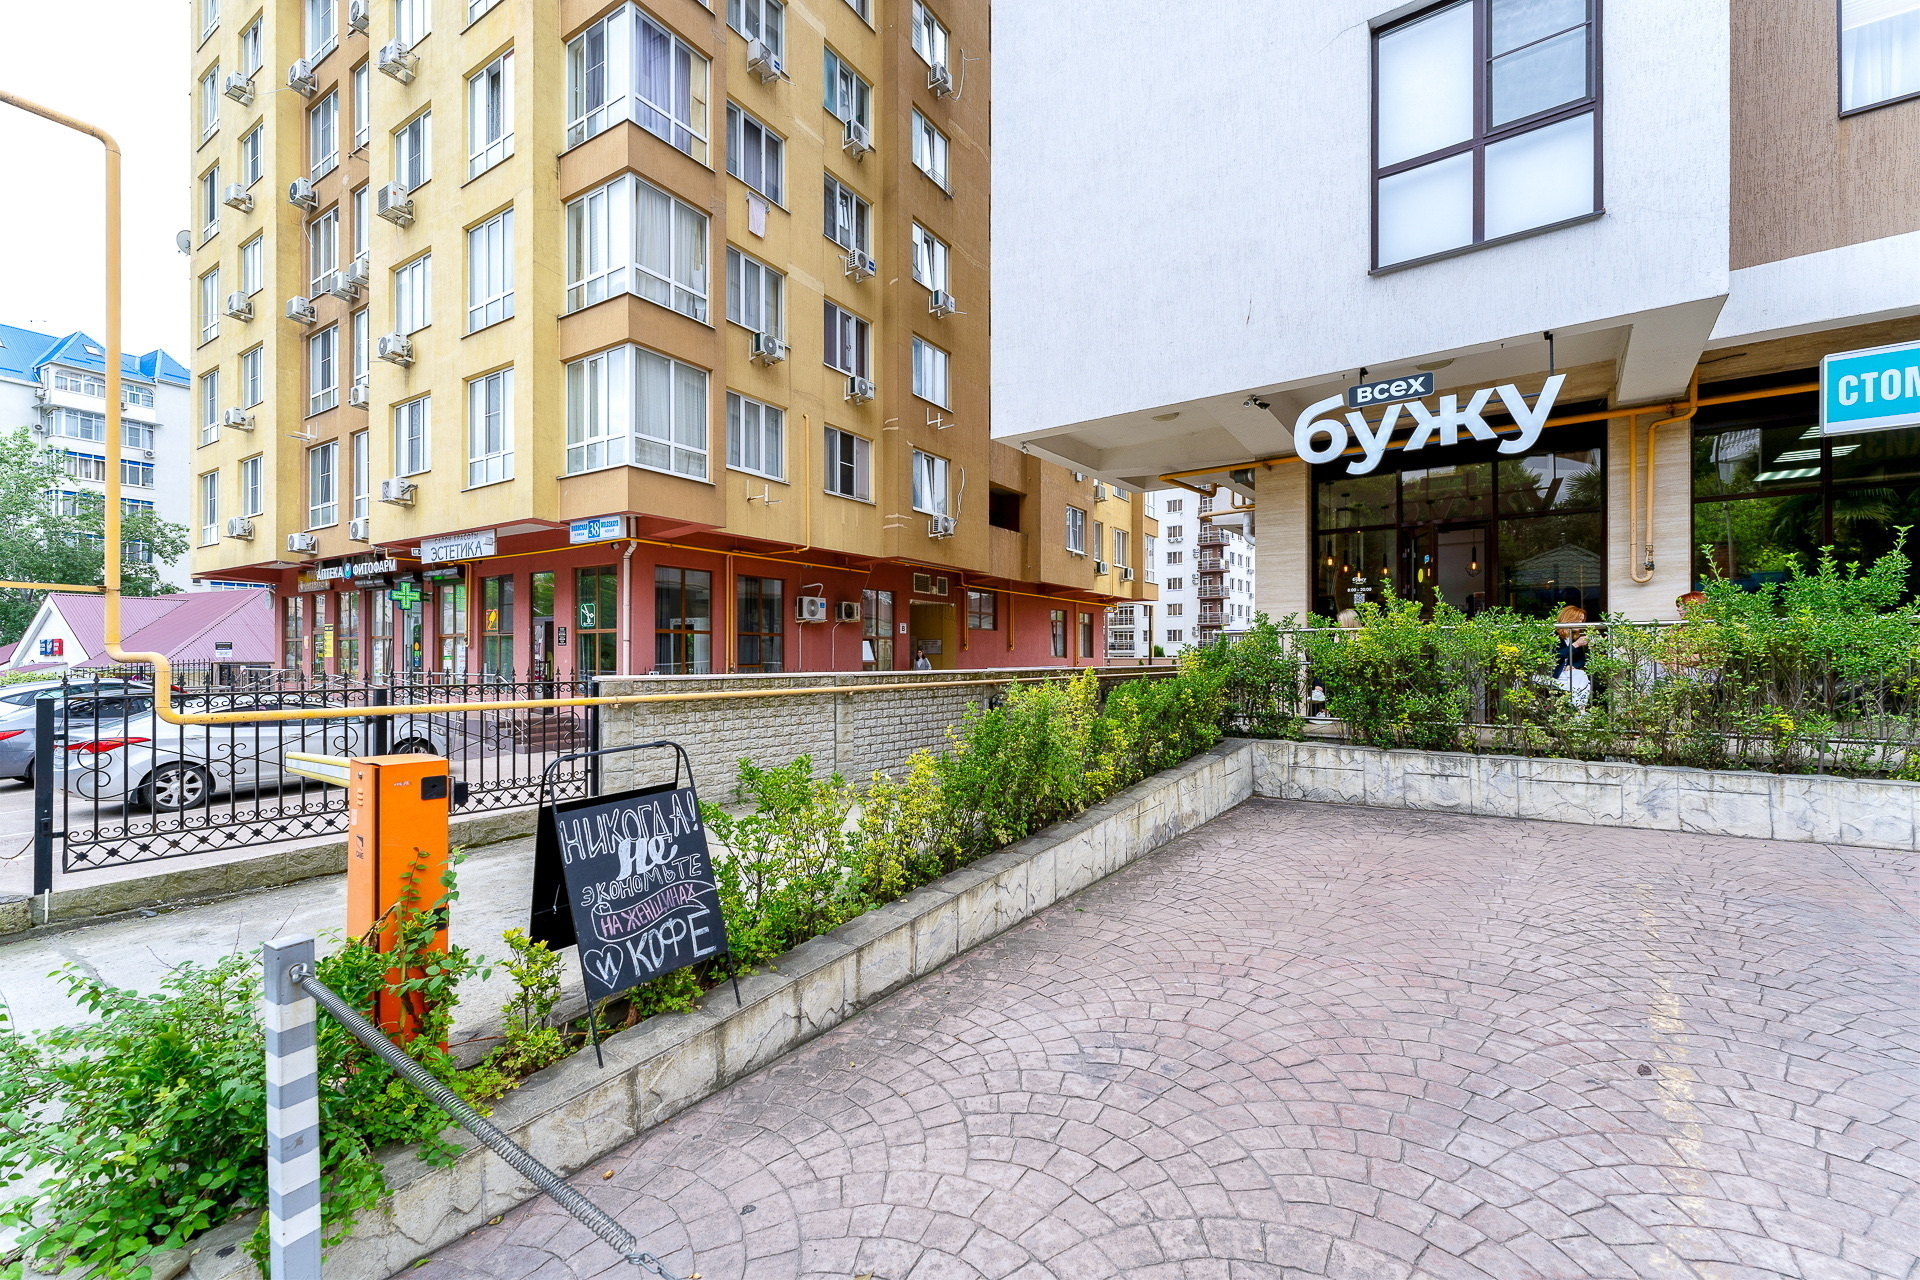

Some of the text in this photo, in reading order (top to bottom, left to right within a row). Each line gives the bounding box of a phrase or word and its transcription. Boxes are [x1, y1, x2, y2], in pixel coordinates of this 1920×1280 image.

[1356, 375, 1426, 403] всех
[1293, 373, 1567, 475] бужу
[453, 532, 479, 542] КРАСОТЫ
[588, 521, 600, 537] 38
[316, 566, 344, 581] АПТЕКА
[352, 559, 398, 576] ФИТОФАРМ
[430, 540, 483, 561] ЭСТЕТИКА
[559, 791, 700, 865] НИКОГДА!
[580, 853, 702, 907] ЭКОНОМЬТЕ
[600, 883, 697, 938] НА ЖЕНЩИНАХ
[626, 909, 718, 978] КОФЕ
